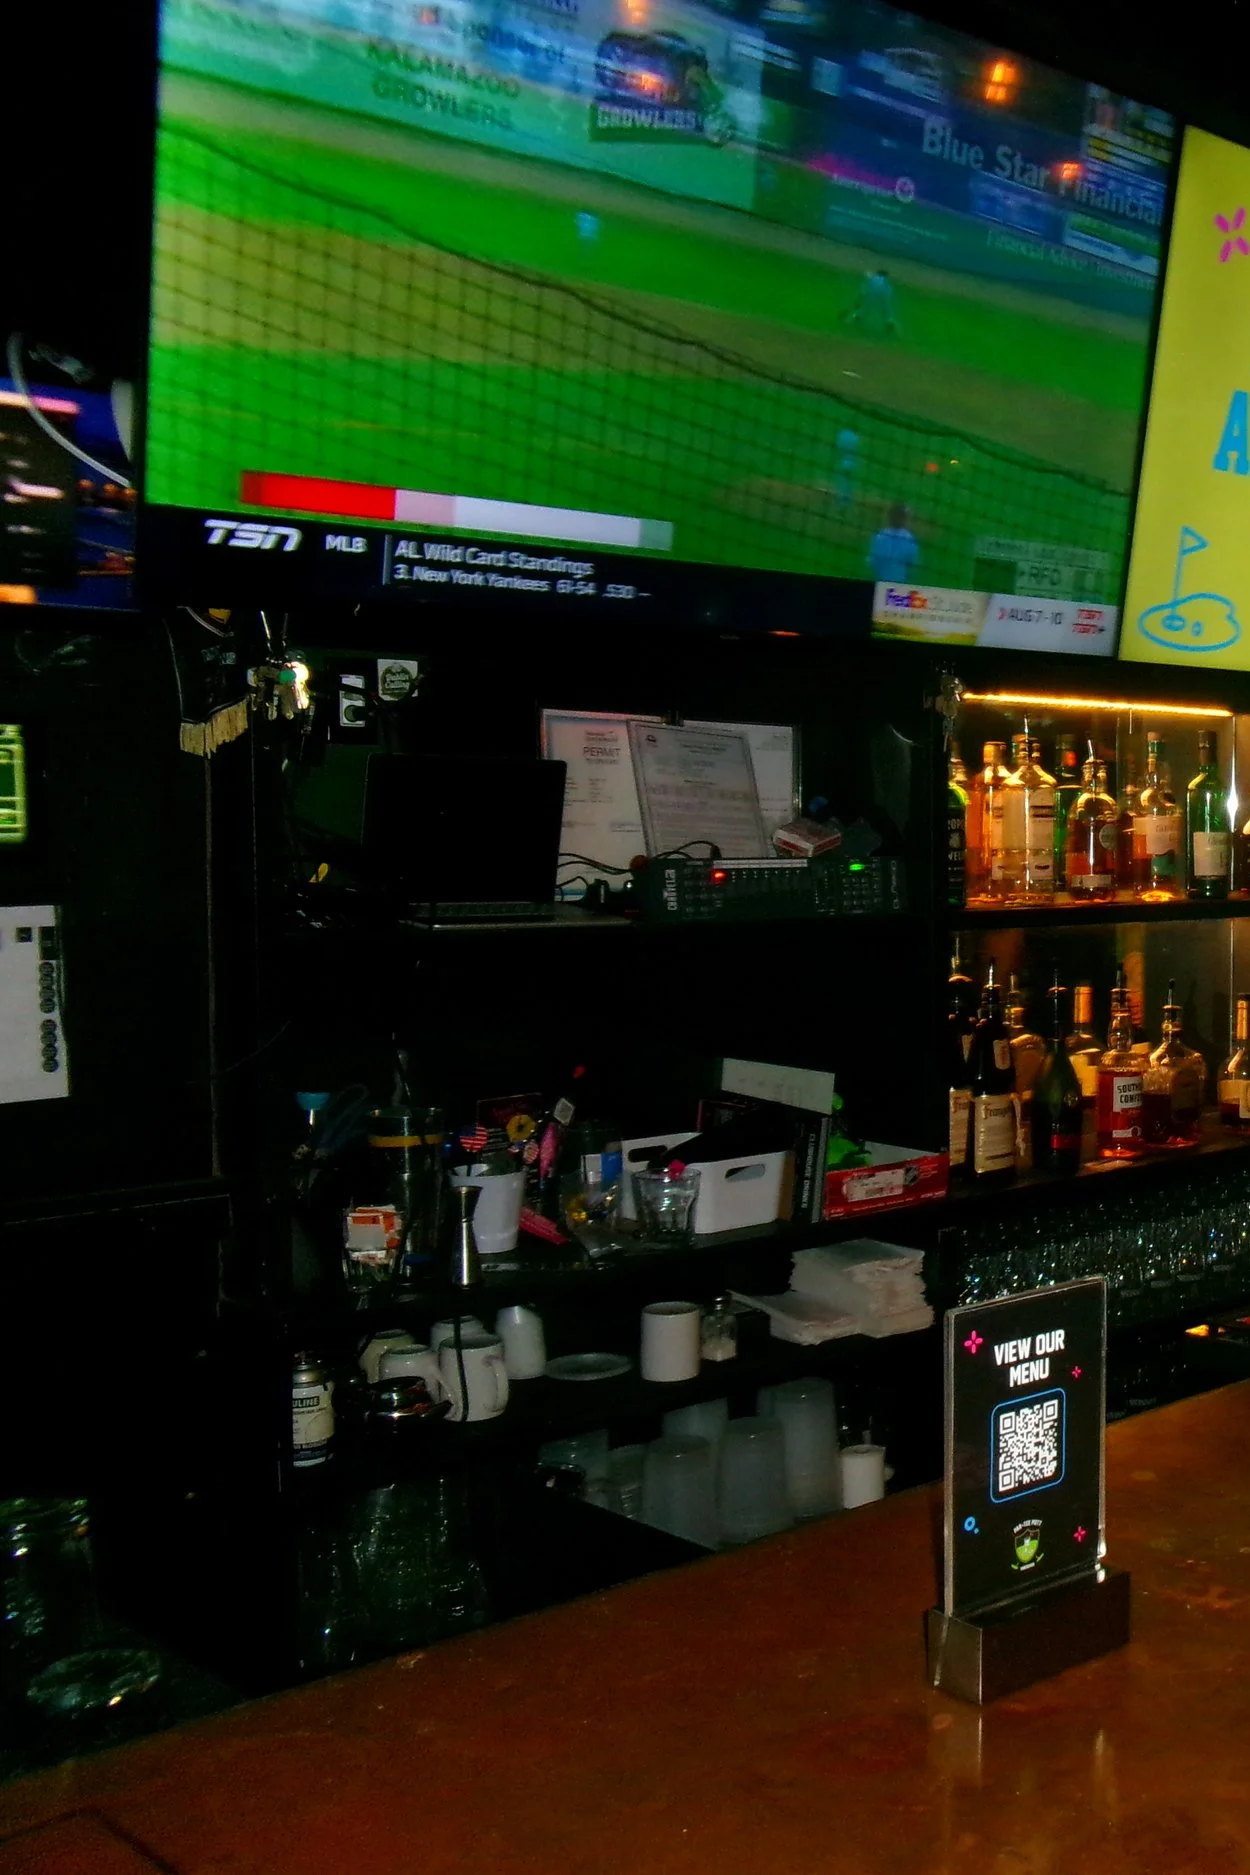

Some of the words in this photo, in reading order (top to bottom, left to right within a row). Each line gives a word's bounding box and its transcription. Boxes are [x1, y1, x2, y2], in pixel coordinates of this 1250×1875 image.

[922, 120, 984, 170] Blue
[994, 144, 1050, 190] Star
[204, 518, 303, 552] TSN
[326, 534, 368, 553] MLB
[394, 540, 422, 559] AL
[423, 542, 466, 564] Wild
[466, 547, 508, 568] Card
[508, 551, 596, 579] Standings
[413, 566, 449, 583] New
[450, 569, 486, 587] York
[486, 574, 551, 592] Yankees
[886, 588, 928, 610] FedEx
[583, 746, 621, 758] PERMIT
[993, 1336, 1033, 1366] VIEW
[1035, 1329, 1065, 1355] OUR
[1009, 1358, 1049, 1388] MENU
